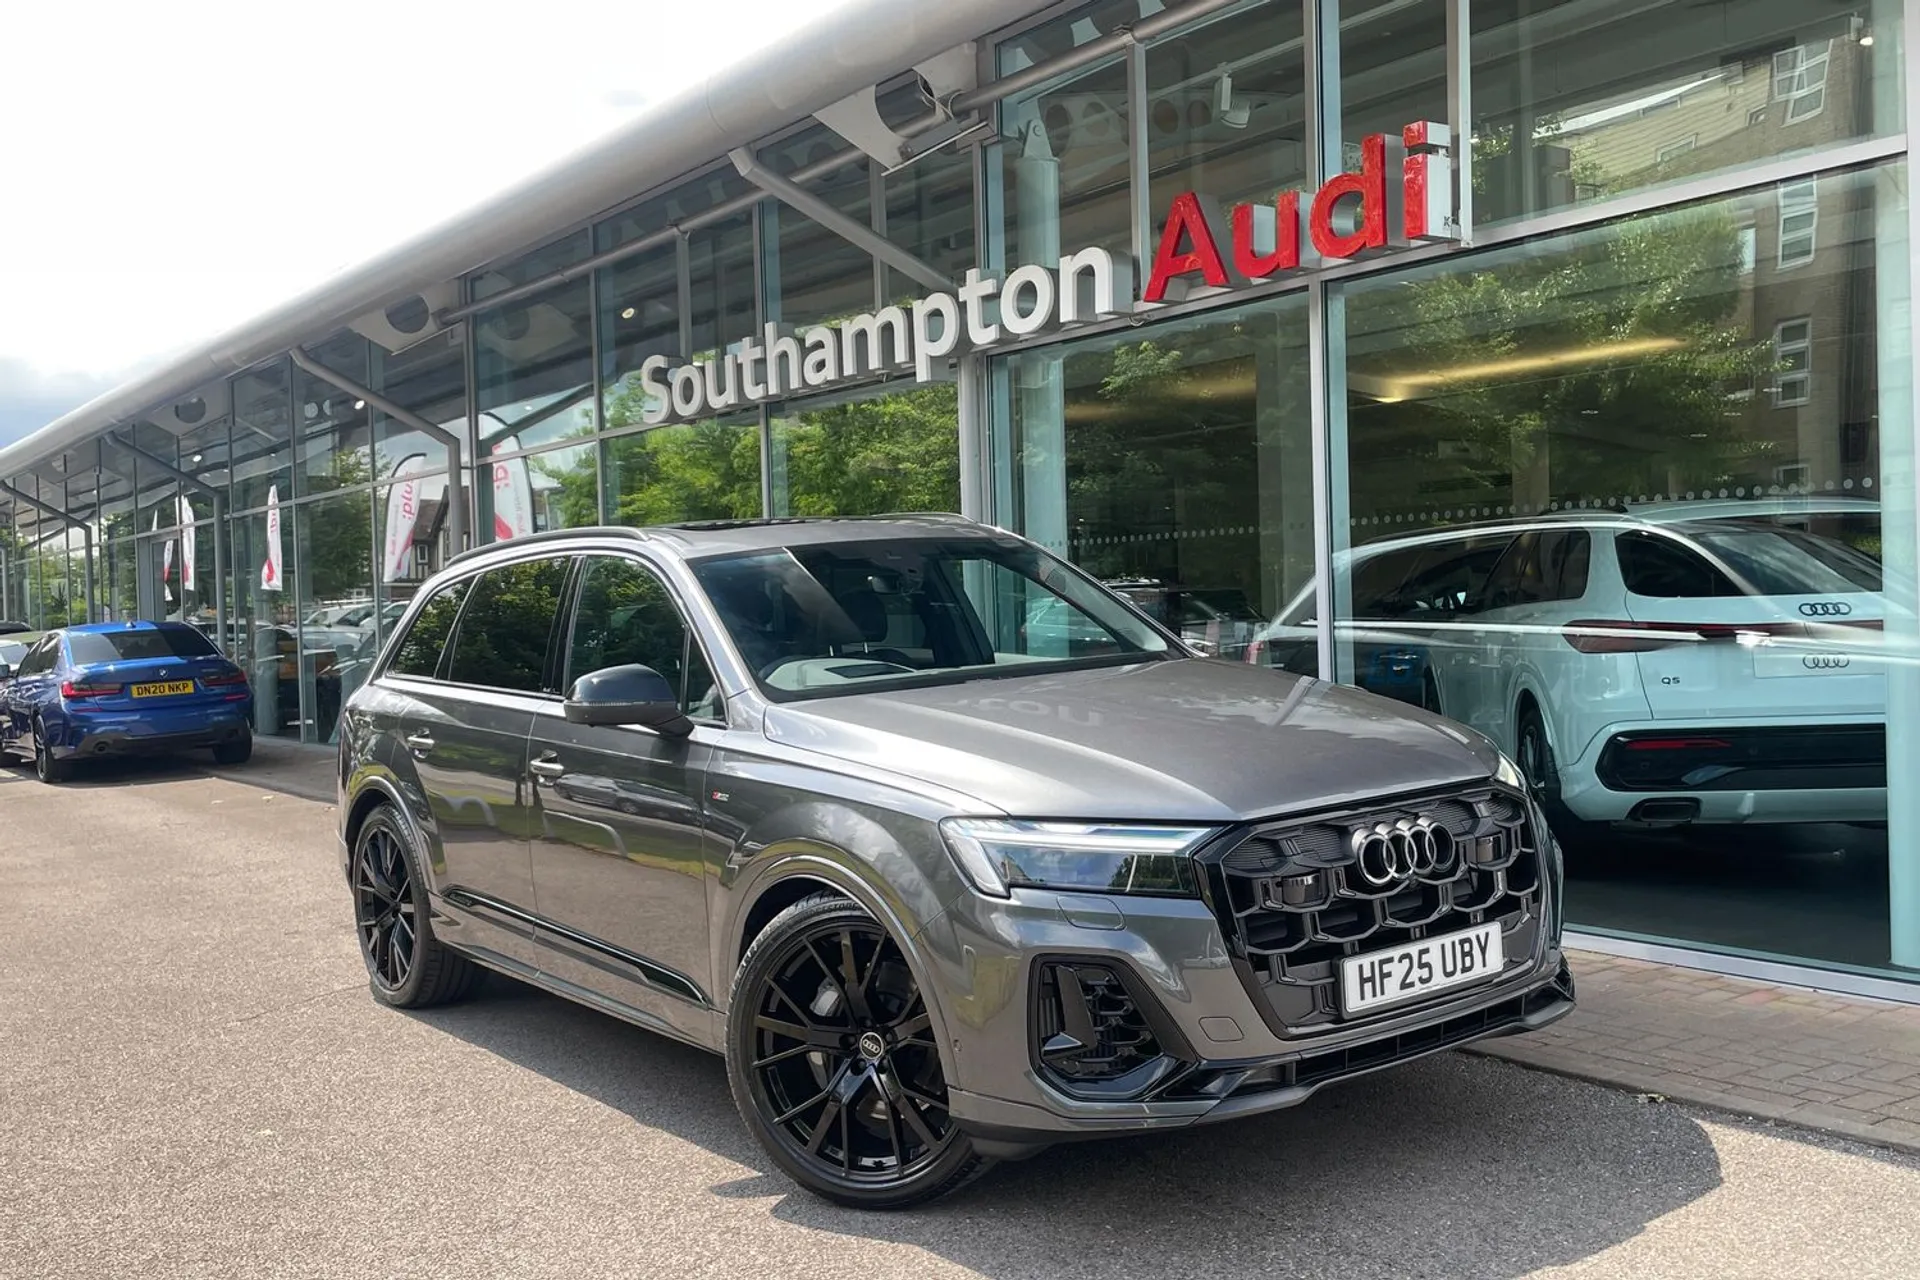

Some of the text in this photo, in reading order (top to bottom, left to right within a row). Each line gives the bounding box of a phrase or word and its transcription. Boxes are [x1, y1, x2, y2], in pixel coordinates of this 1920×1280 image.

[641, 120, 1432, 425] Southampton Audi
[136, 682, 189, 696] DN20 NKP
[1661, 676, 1681, 686] Q5
[1358, 931, 1490, 1001] HF25 UBY
